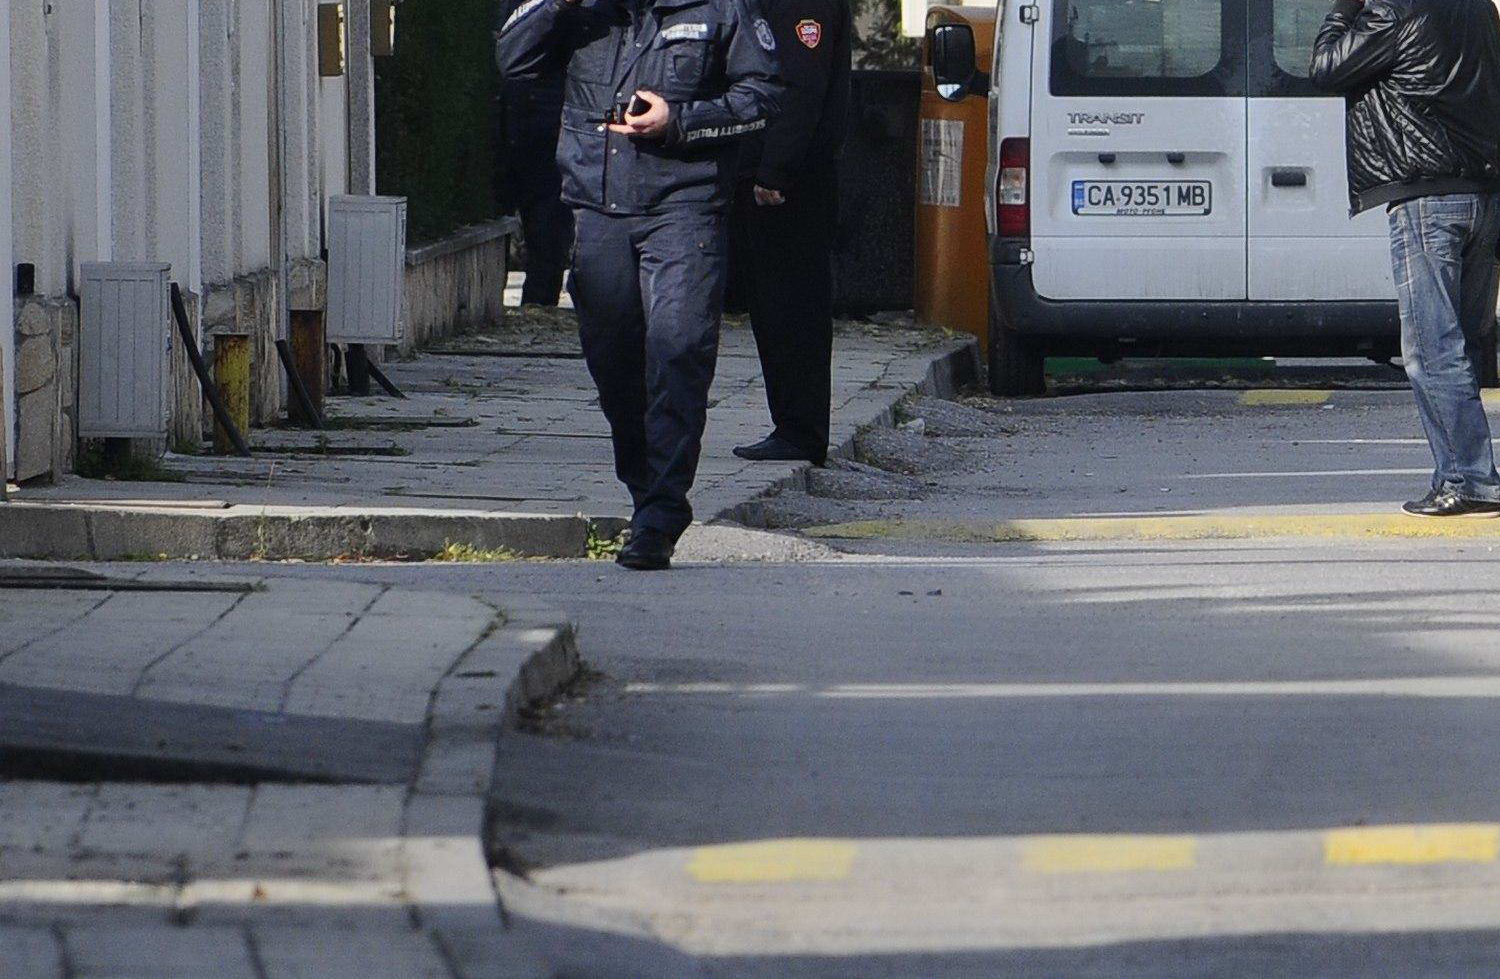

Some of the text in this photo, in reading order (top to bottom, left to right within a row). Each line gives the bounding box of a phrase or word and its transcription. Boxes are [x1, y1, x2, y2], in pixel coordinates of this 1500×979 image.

[1067, 112, 1145, 124] TRANSIT
[1087, 185, 1205, 207] CA 9351 MB
